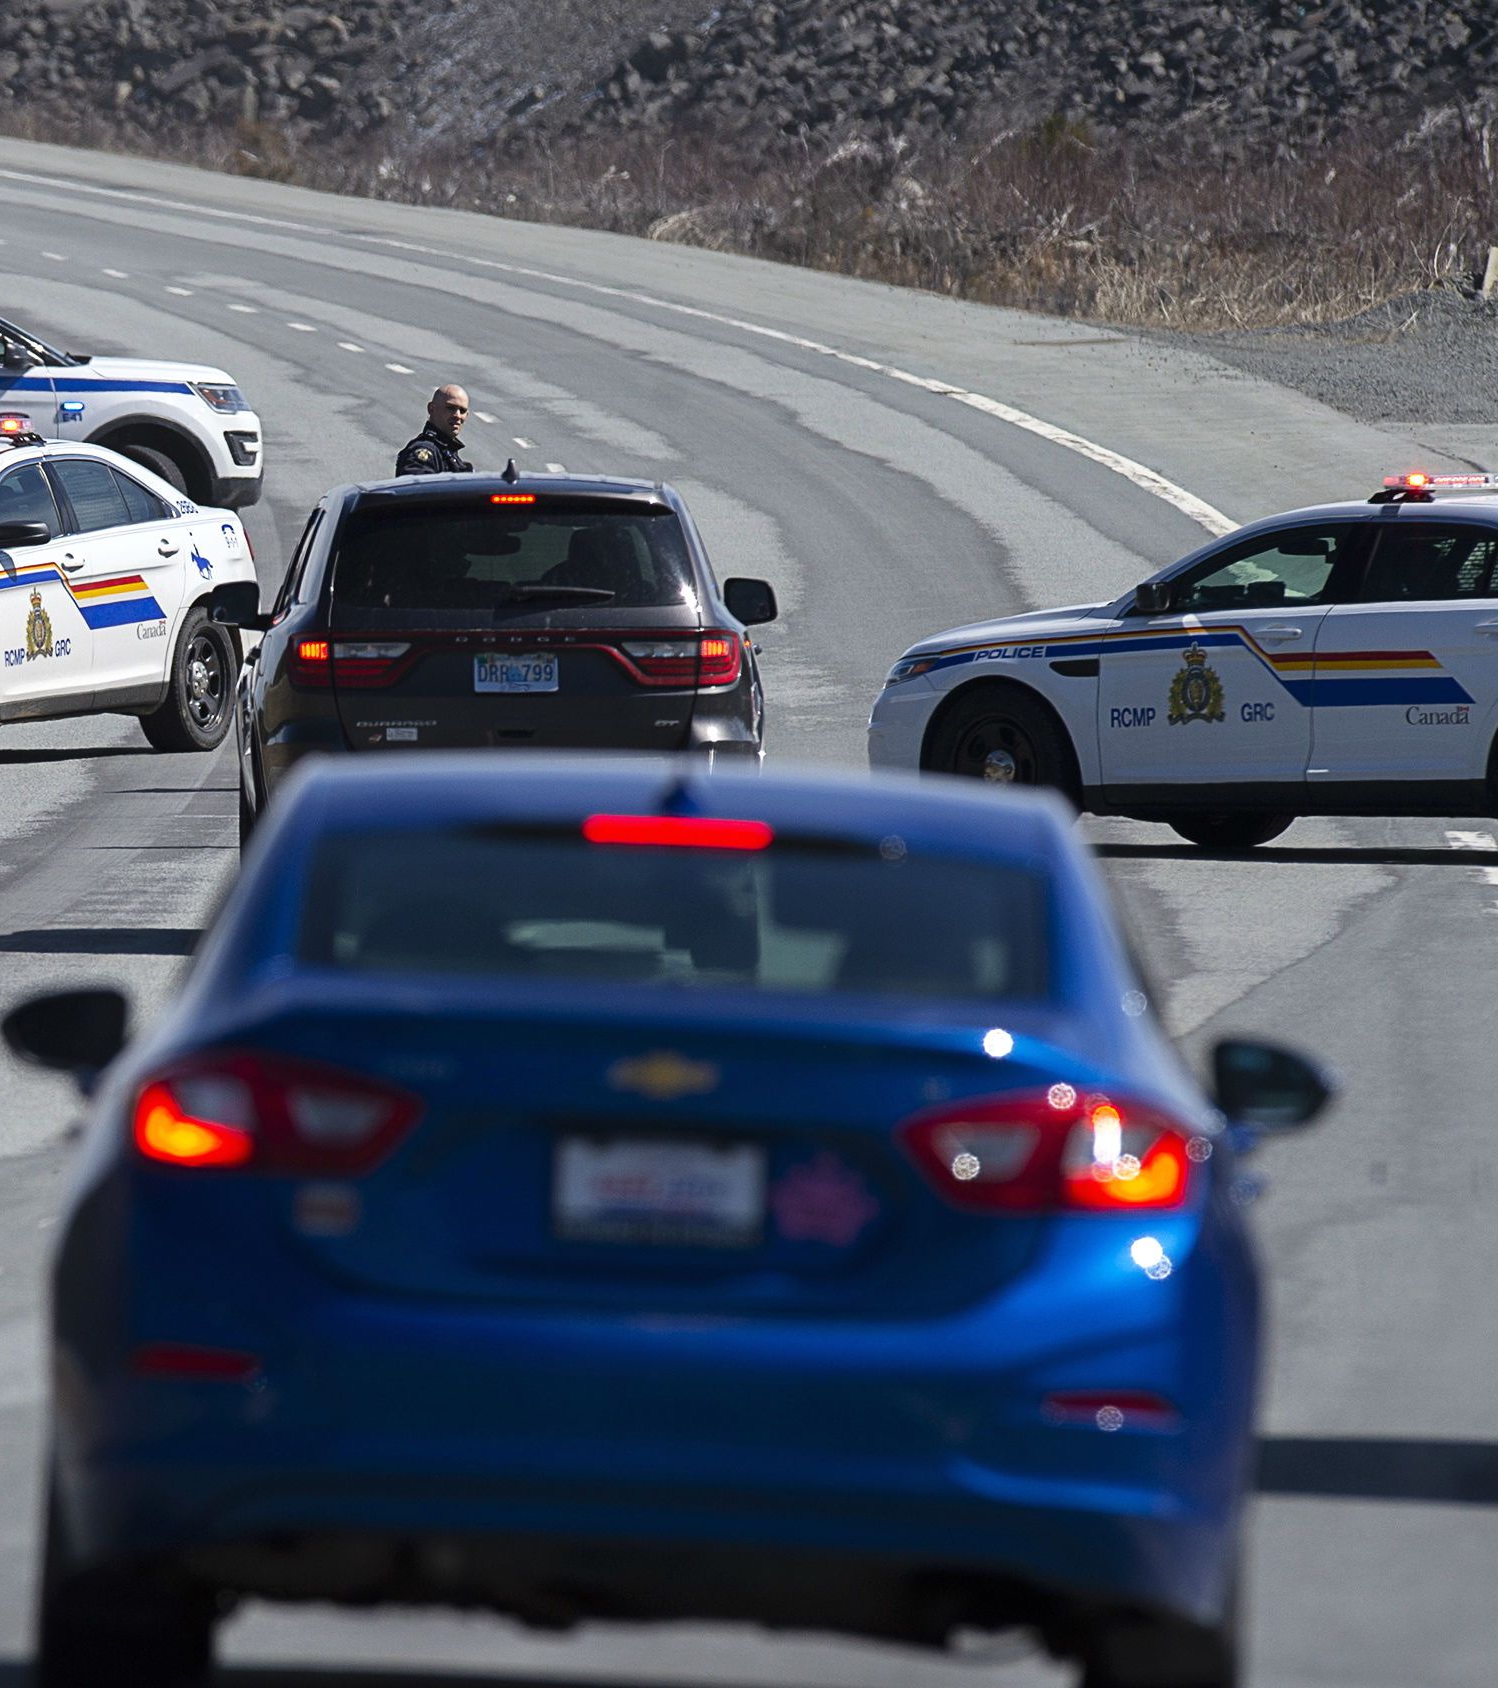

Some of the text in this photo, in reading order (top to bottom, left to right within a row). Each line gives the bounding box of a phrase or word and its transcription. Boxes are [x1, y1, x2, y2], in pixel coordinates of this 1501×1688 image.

[136, 623, 167, 640] Canada
[4, 638, 71, 667] RCMP GRC
[975, 646, 1046, 660] POLICE
[478, 664, 554, 682] DRR 799
[1110, 703, 1275, 728] RCMP GRC
[1405, 706, 1471, 725] Canada
